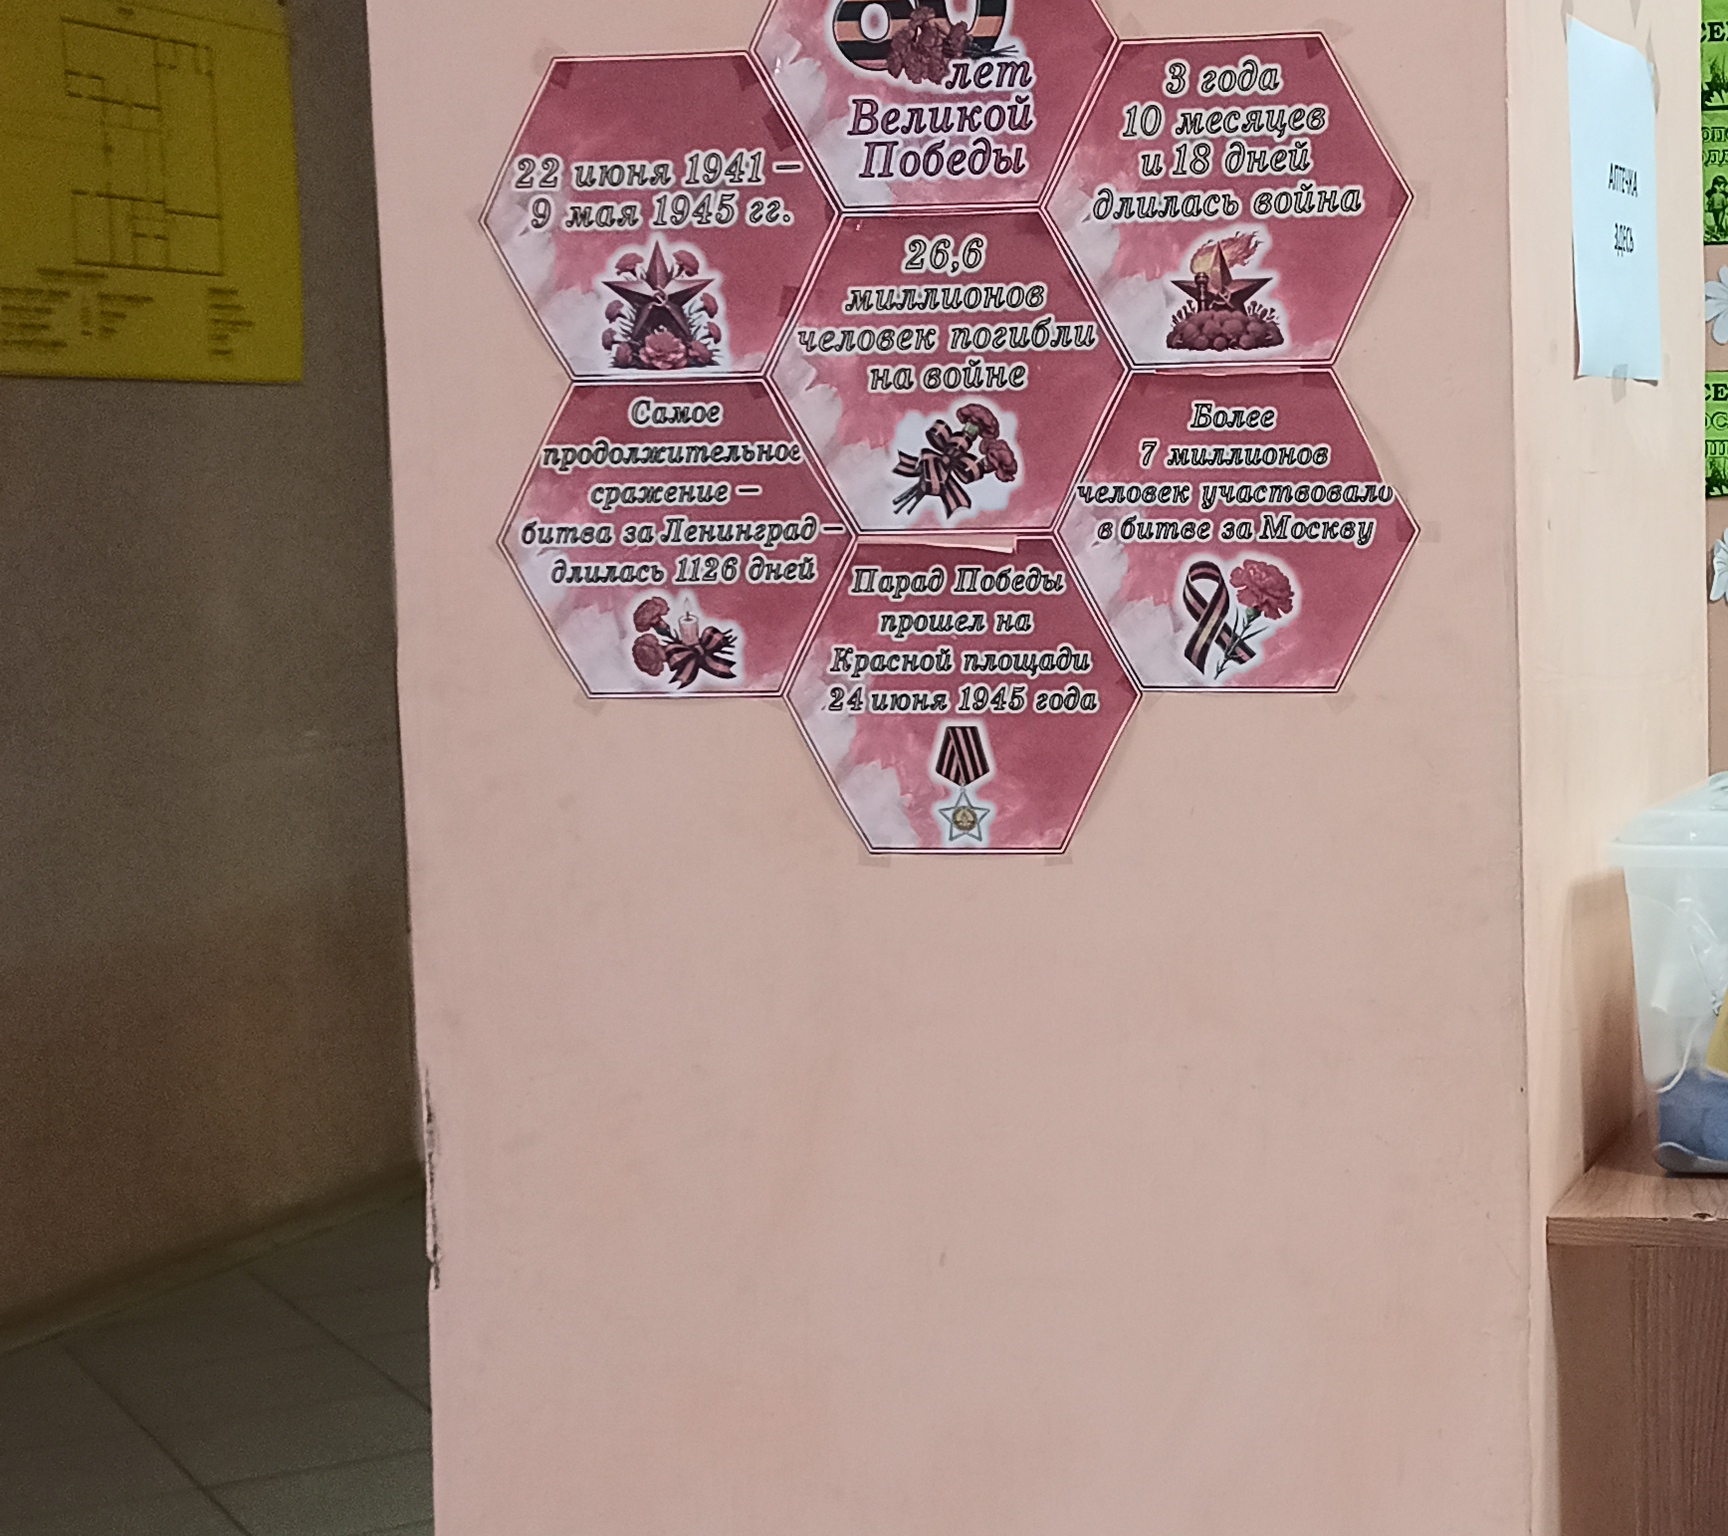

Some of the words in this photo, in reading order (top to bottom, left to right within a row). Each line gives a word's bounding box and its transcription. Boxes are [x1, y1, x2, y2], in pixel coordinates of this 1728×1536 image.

[945, 60, 1033, 89] лет
[1165, 62, 1186, 94] 3
[1201, 60, 1280, 92] года
[847, 95, 1034, 136] Великой
[1122, 105, 1163, 137] 10
[1175, 107, 1326, 138] месяцев
[515, 157, 559, 188] 22
[574, 162, 671, 187] июня
[685, 151, 764, 185] 1941
[858, 137, 1027, 178] Победы
[1141, 151, 1162, 176] и
[1173, 143, 1211, 175] 18
[1224, 141, 1310, 173] дней
[1608, 163, 1639, 198] АПТЕЧКА
[531, 198, 551, 228] 9
[565, 203, 639, 228] мая
[653, 193, 735, 225] 1945
[749, 200, 791, 223] гг.
[1093, 188, 1239, 219] длилась
[1253, 183, 1362, 214] война
[905, 237, 984, 274] 26,6
[845, 285, 1045, 311] миллионов
[798, 327, 936, 352] человек
[950, 316, 1096, 349] погибли
[870, 366, 914, 390] на
[923, 359, 1027, 389] войне
[631, 400, 720, 425] Самое
[1190, 403, 1275, 428] Более
[543, 440, 800, 471] продолжительное
[1140, 440, 1158, 465] 7
[1167, 446, 1329, 466] миллионов
[591, 485, 728, 510] сражение
[1077, 484, 1190, 504] человек
[1201, 484, 1394, 508] участвовало
[521, 521, 612, 544] битва
[623, 527, 654, 544] за
[661, 516, 818, 547] Ленинград
[1098, 520, 1113, 539] в
[1120, 516, 1211, 539] битве
[1222, 522, 1253, 539] за
[1259, 515, 1374, 545] Москву
[551, 559, 664, 583] длилась
[676, 557, 738, 582] 1126
[749, 556, 816, 580] дней
[851, 568, 945, 598] Парад
[954, 567, 1064, 592] Победы
[880, 613, 985, 637] прошел
[996, 614, 1031, 632] на
[830, 648, 952, 676] Красной
[963, 645, 1092, 675] площади
[828, 687, 863, 711] 24
[872, 692, 947, 711] июня
[958, 686, 1026, 711] 1945
[1036, 687, 1097, 711] года
